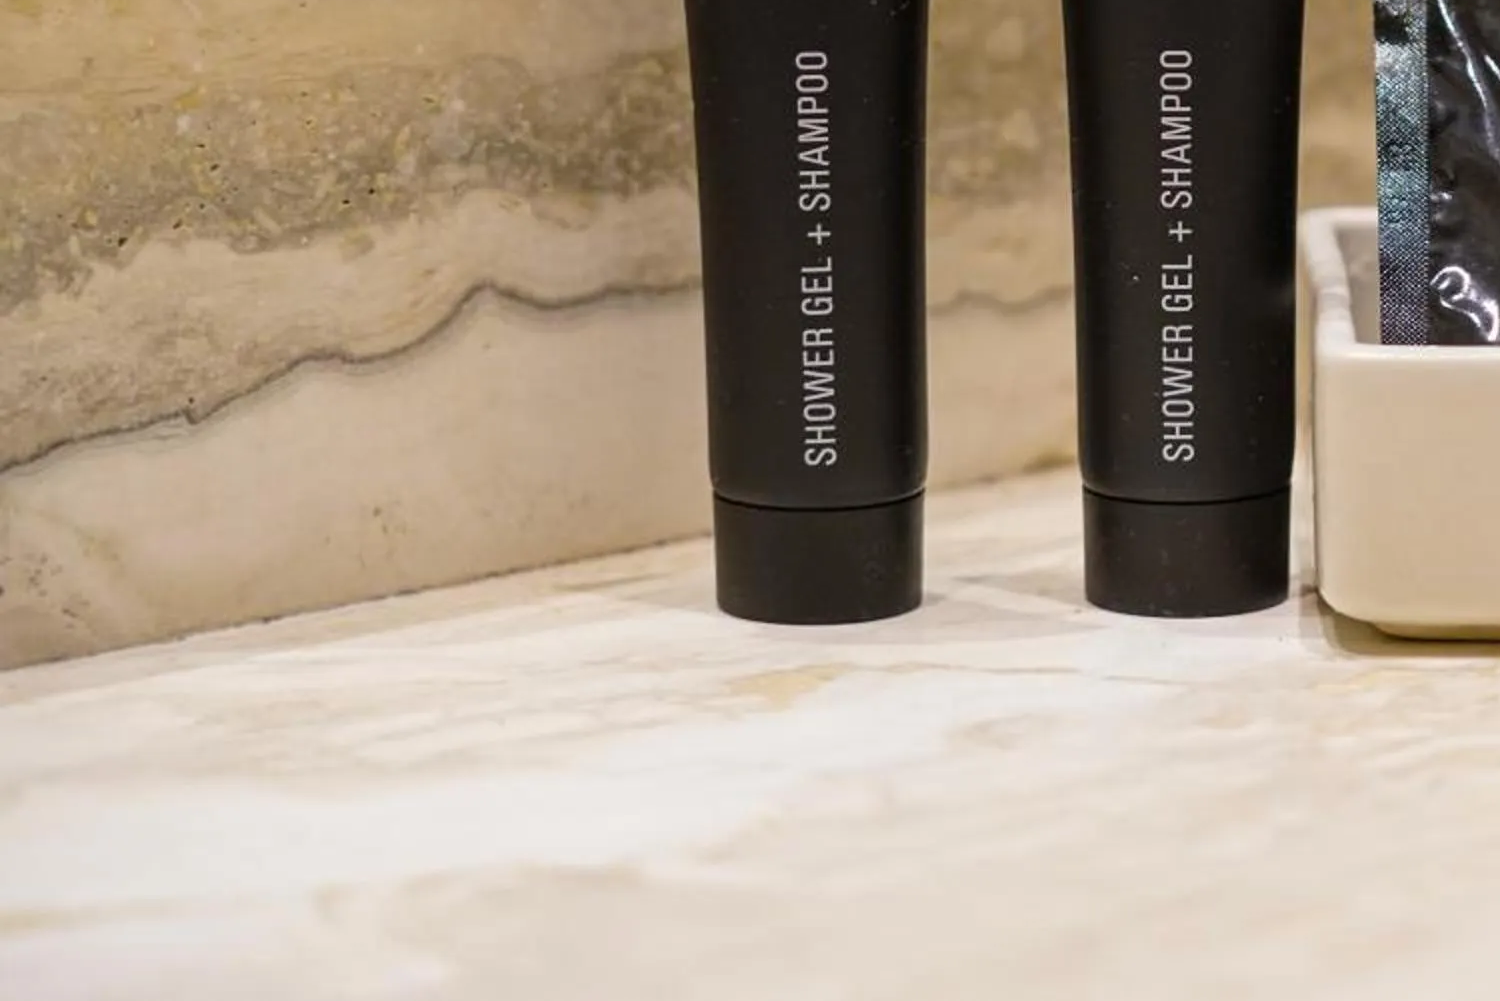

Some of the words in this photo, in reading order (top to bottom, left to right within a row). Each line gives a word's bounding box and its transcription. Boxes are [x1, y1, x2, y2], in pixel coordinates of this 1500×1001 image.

[795, 50, 832, 212] SHAMPOO
[1158, 49, 1193, 209] SHAMPOO
[807, 223, 832, 246] +
[1168, 220, 1193, 243] +
[800, 255, 834, 317] GEL
[1160, 253, 1194, 313] GEL
[801, 327, 838, 467] SHOWER
[1161, 324, 1195, 463] SHOWER
